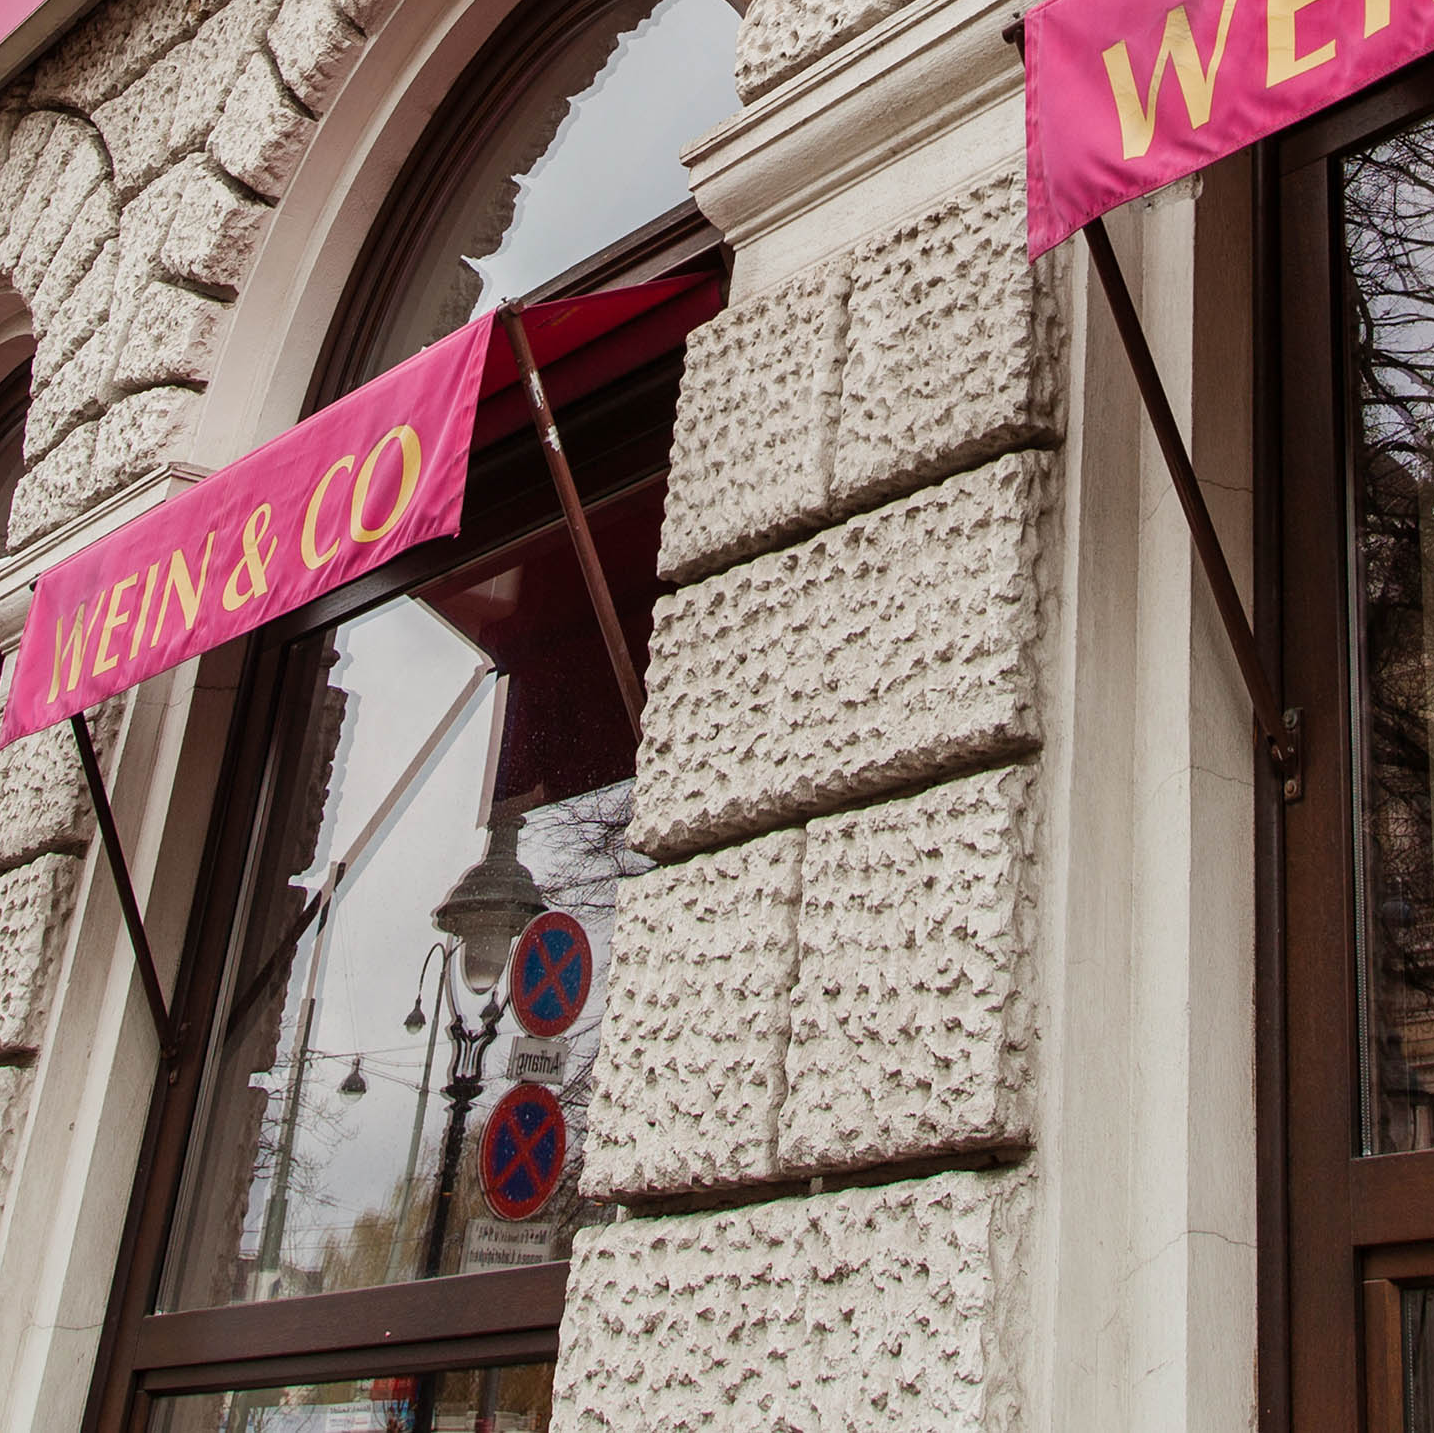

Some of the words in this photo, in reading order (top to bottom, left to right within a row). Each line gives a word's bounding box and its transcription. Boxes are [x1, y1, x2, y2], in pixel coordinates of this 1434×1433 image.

[45, 531, 217, 704] WEIN
[222, 502, 278, 612] &
[300, 424, 422, 570] CO
